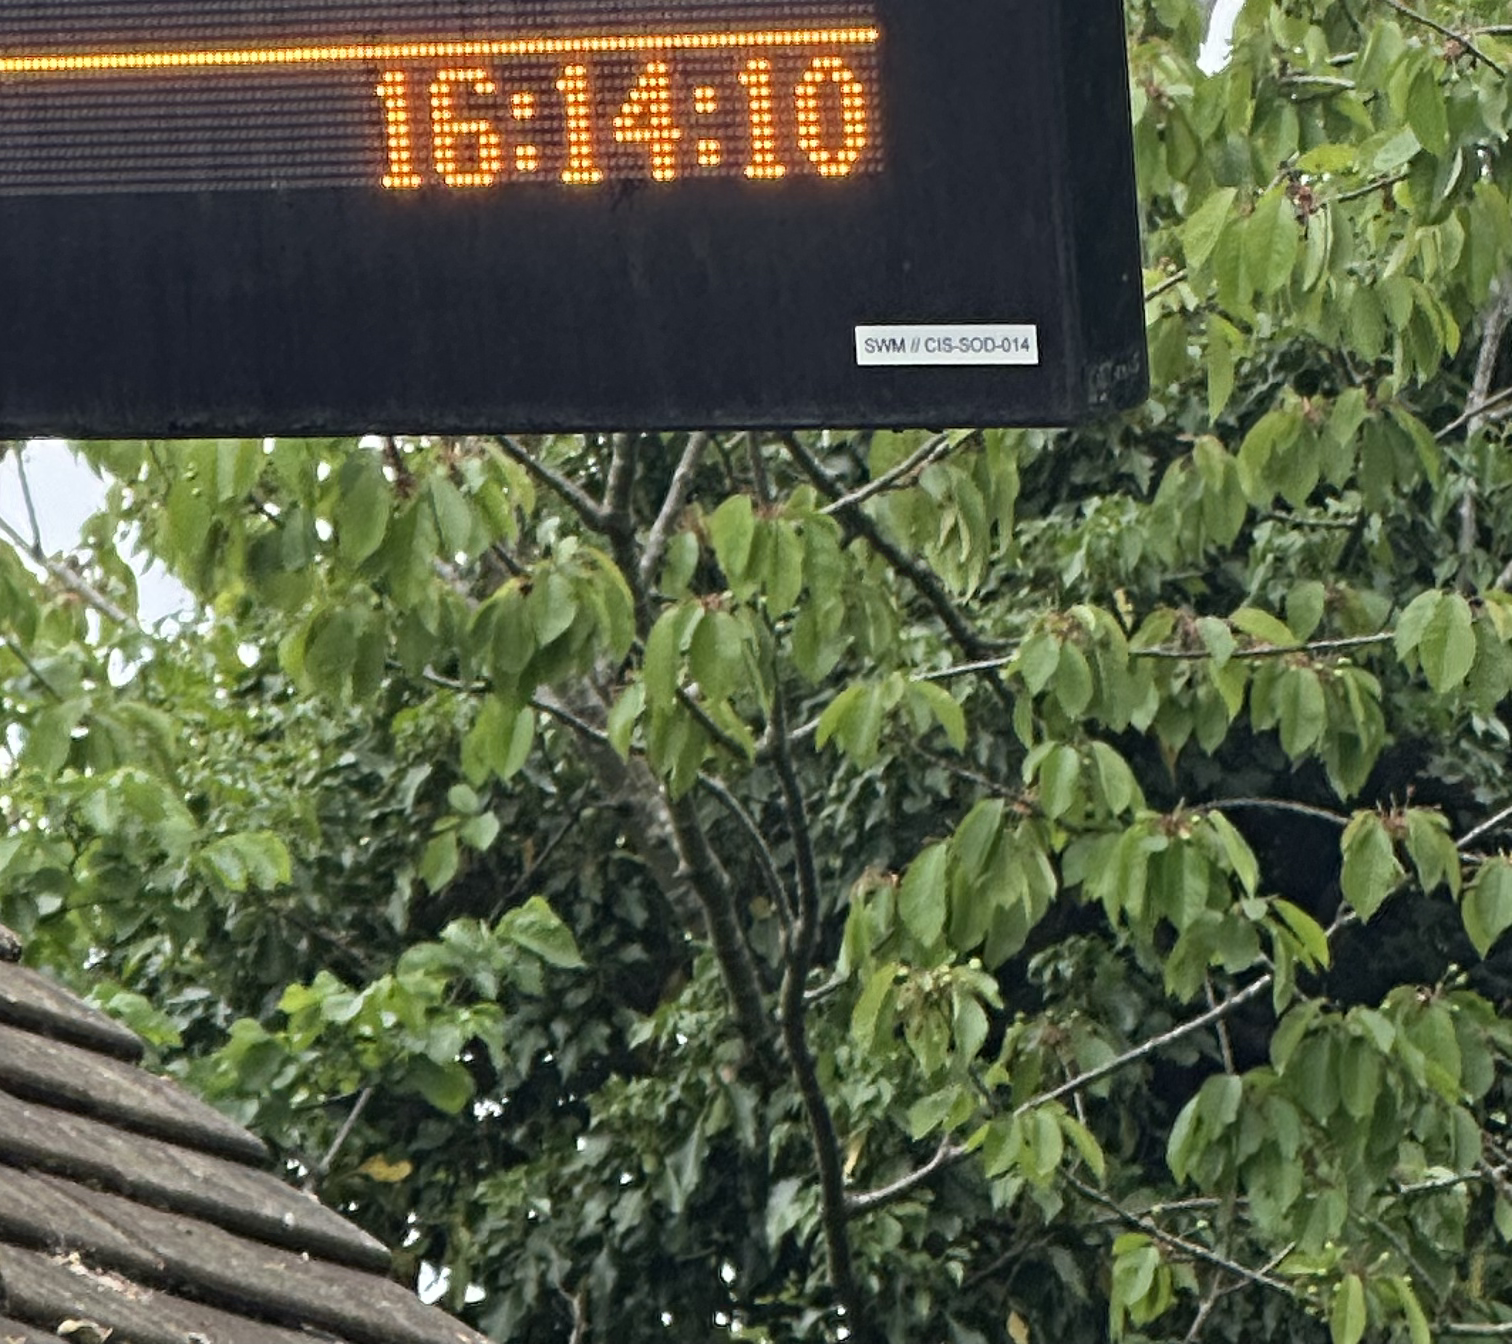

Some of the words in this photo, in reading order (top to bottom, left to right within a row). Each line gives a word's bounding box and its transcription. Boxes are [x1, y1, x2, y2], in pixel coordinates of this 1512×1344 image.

[375, 55, 867, 189] 16:14:10
[864, 337, 906, 354] SWM
[924, 336, 1030, 353] CIS-SOD-014
